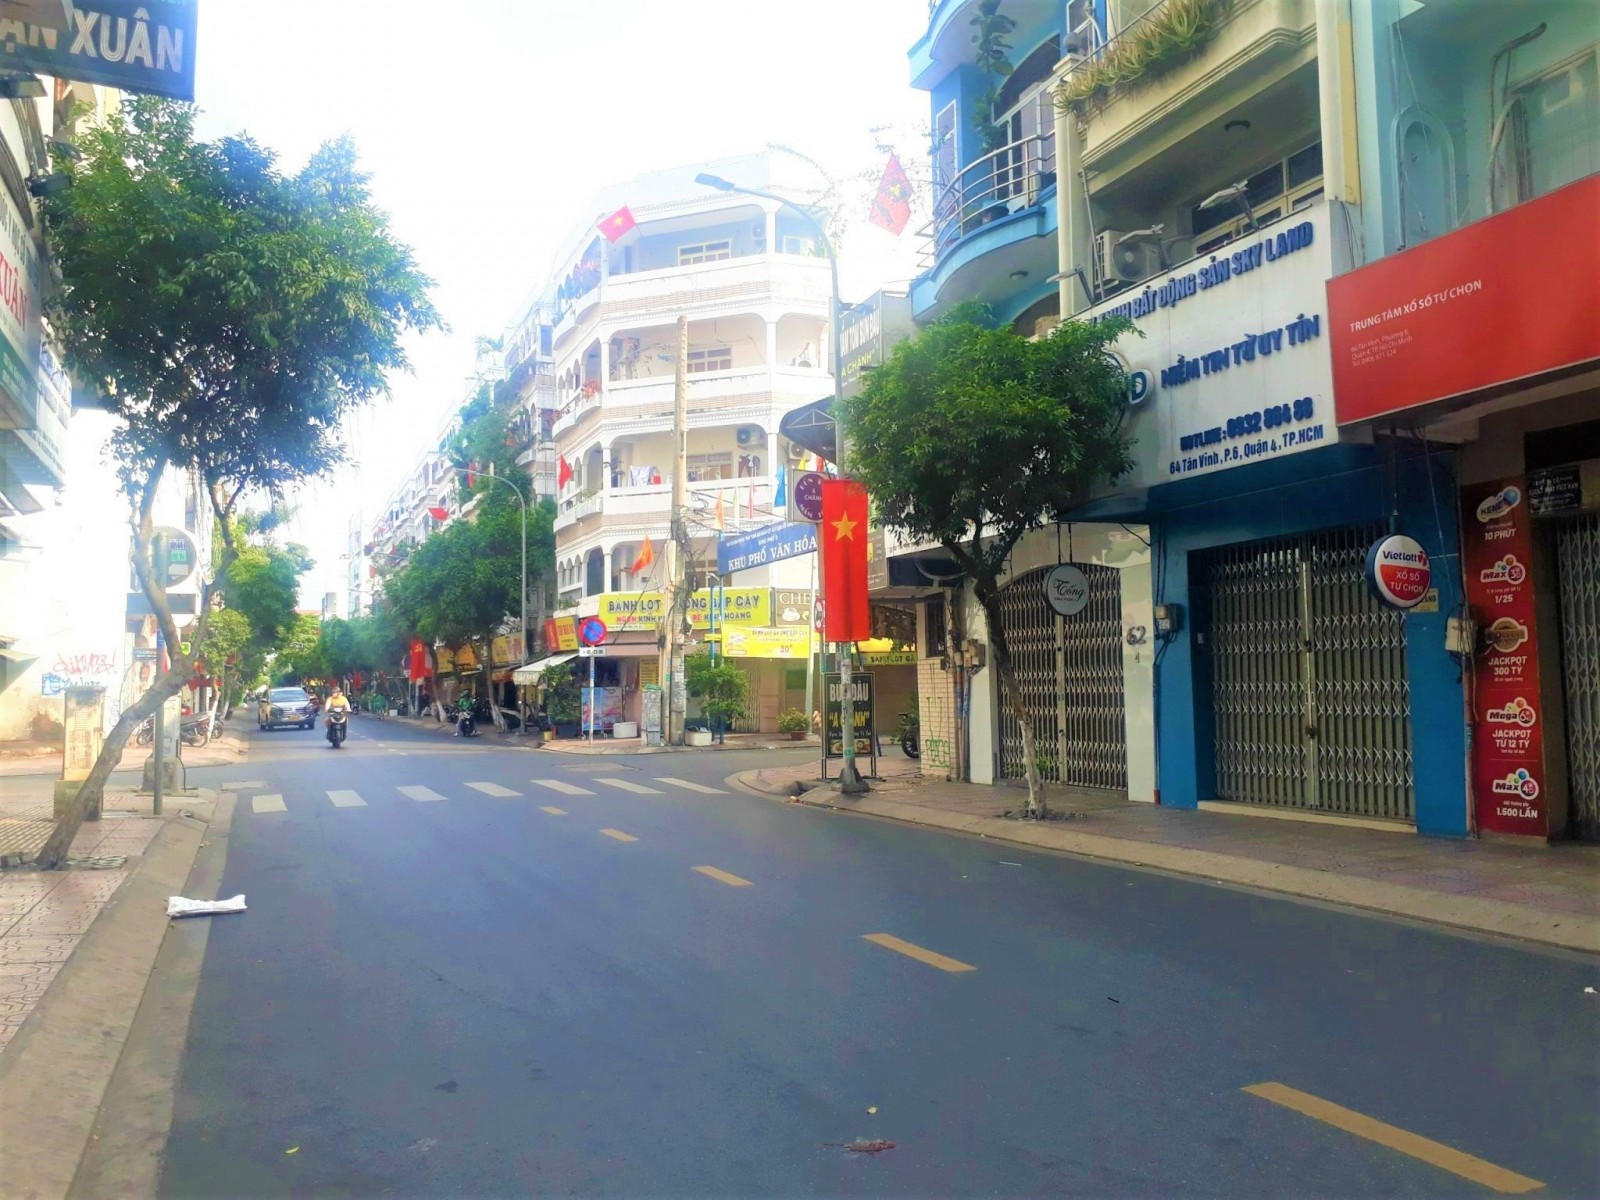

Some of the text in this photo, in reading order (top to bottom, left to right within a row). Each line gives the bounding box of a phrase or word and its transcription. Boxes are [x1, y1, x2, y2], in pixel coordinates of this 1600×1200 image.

[70, 7, 184, 73] XUÂN
[1158, 273, 1197, 309] ĐỘNG
[1198, 255, 1231, 291] SẢN
[1231, 243, 1264, 275] SKY
[1265, 221, 1314, 262] LAND
[1349, 314, 1381, 333] TRUNG
[1381, 306, 1402, 322] TÂM
[1433, 288, 1448, 304] TỰ
[1449, 279, 1482, 298] CHỌN
[1200, 347, 1230, 375] TIN
[1257, 328, 1283, 355] UY
[1285, 313, 1320, 346] TÍN
[1170, 460, 1181, 475] 64
[1182, 455, 1198, 473] Tân
[1244, 439, 1268, 457] Quận
[1282, 424, 1324, 448] TP.HCM
[1484, 528, 1517, 540] 10 PHÚT
[728, 557, 746, 571] KHU
[748, 545, 767, 567] PHỐ
[770, 542, 791, 559] VĂN
[794, 534, 817, 552] HÓA
[1383, 551, 1417, 562] Vietlott
[1483, 571, 1507, 580] Max
[1495, 594, 1513, 604] 1/25
[1494, 667, 1510, 675] 300
[1489, 712, 1518, 720] Mega
[1492, 729, 1532, 739] JACKPOT
[1508, 739, 1517, 748] 12
[1495, 782, 1519, 791] Max
[1496, 808, 1518, 817] 1.500
